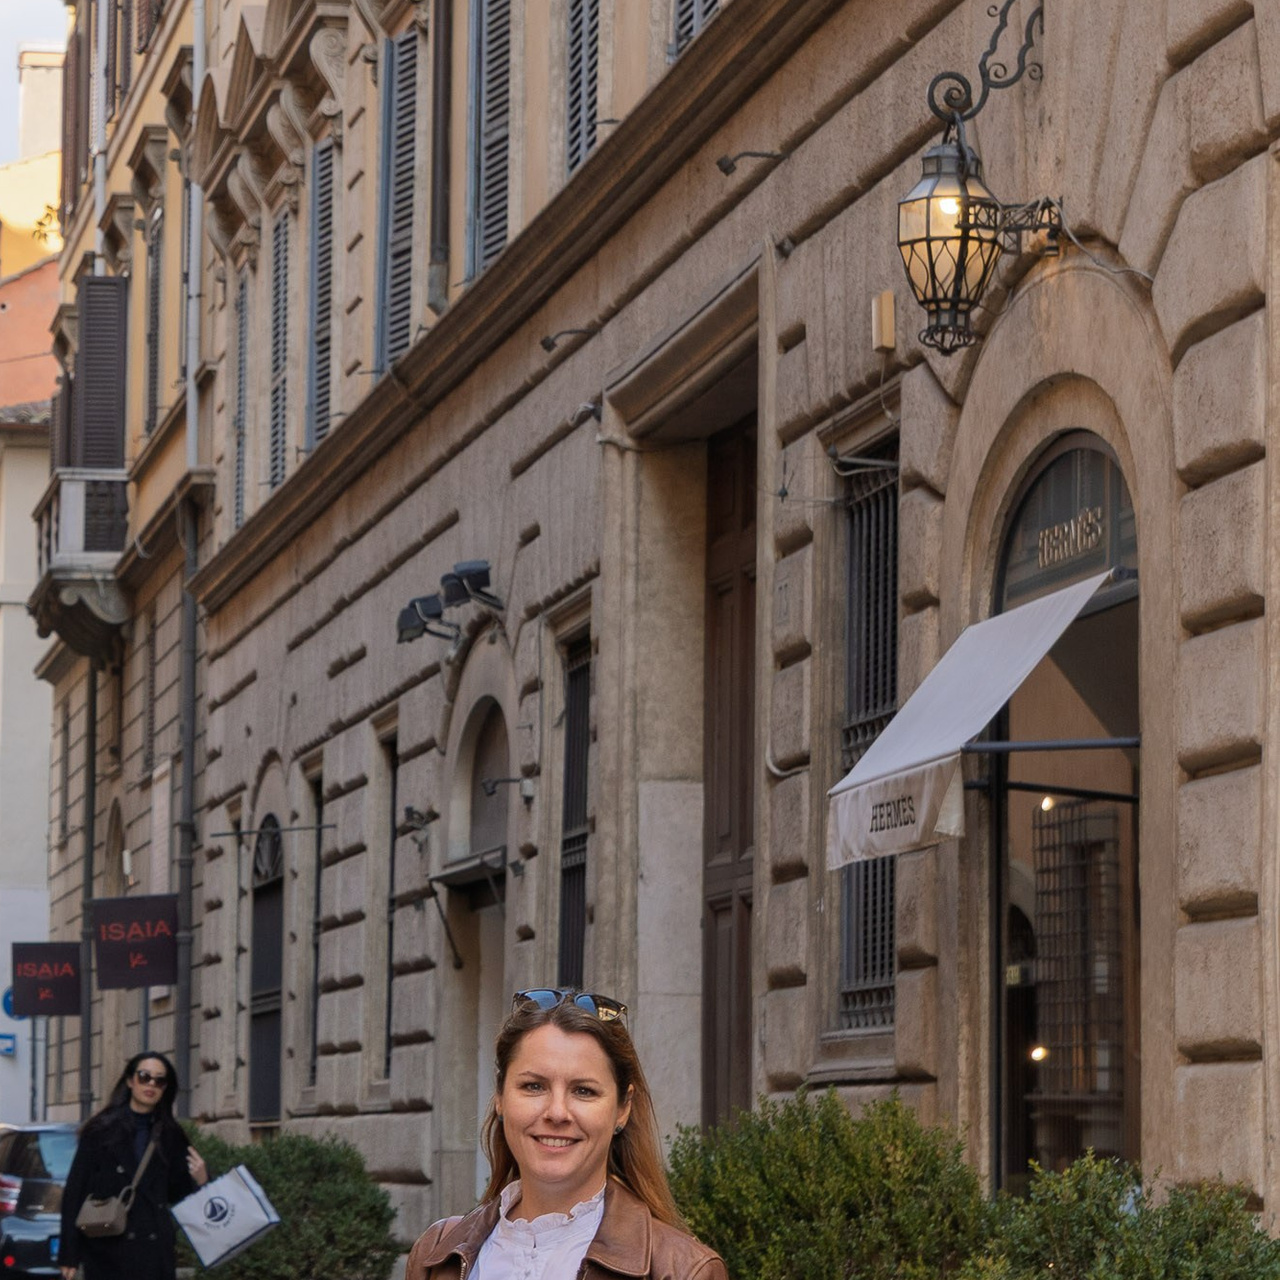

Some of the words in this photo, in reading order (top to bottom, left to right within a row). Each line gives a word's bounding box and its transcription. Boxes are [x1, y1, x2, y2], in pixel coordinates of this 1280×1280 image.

[869, 794, 916, 833] HERMÈS
[100, 919, 172, 943] ISAIA
[16, 962, 75, 979] ISAIA
